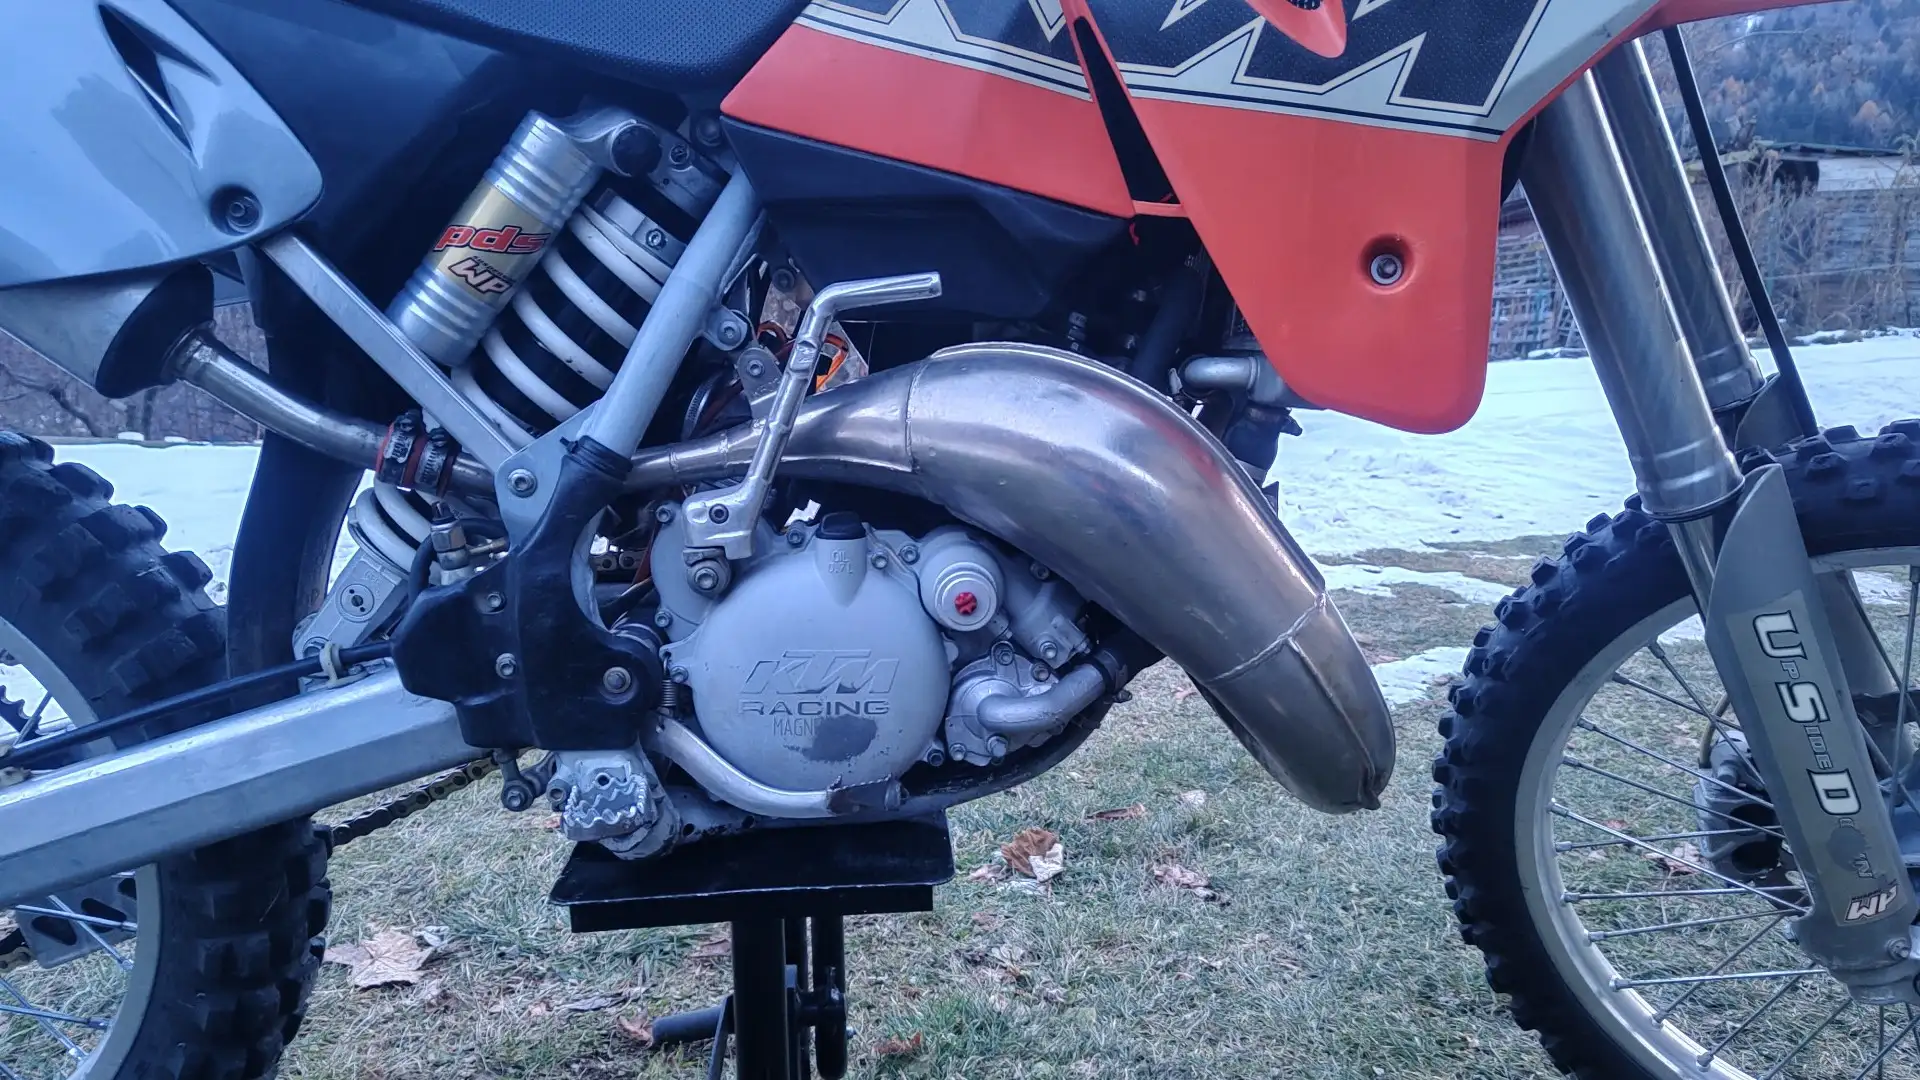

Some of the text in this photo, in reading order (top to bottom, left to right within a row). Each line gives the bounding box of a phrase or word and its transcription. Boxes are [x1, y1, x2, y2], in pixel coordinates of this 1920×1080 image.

[448, 257, 514, 294] WP
[740, 649, 899, 694] KTM
[739, 700, 890, 716] RACING
